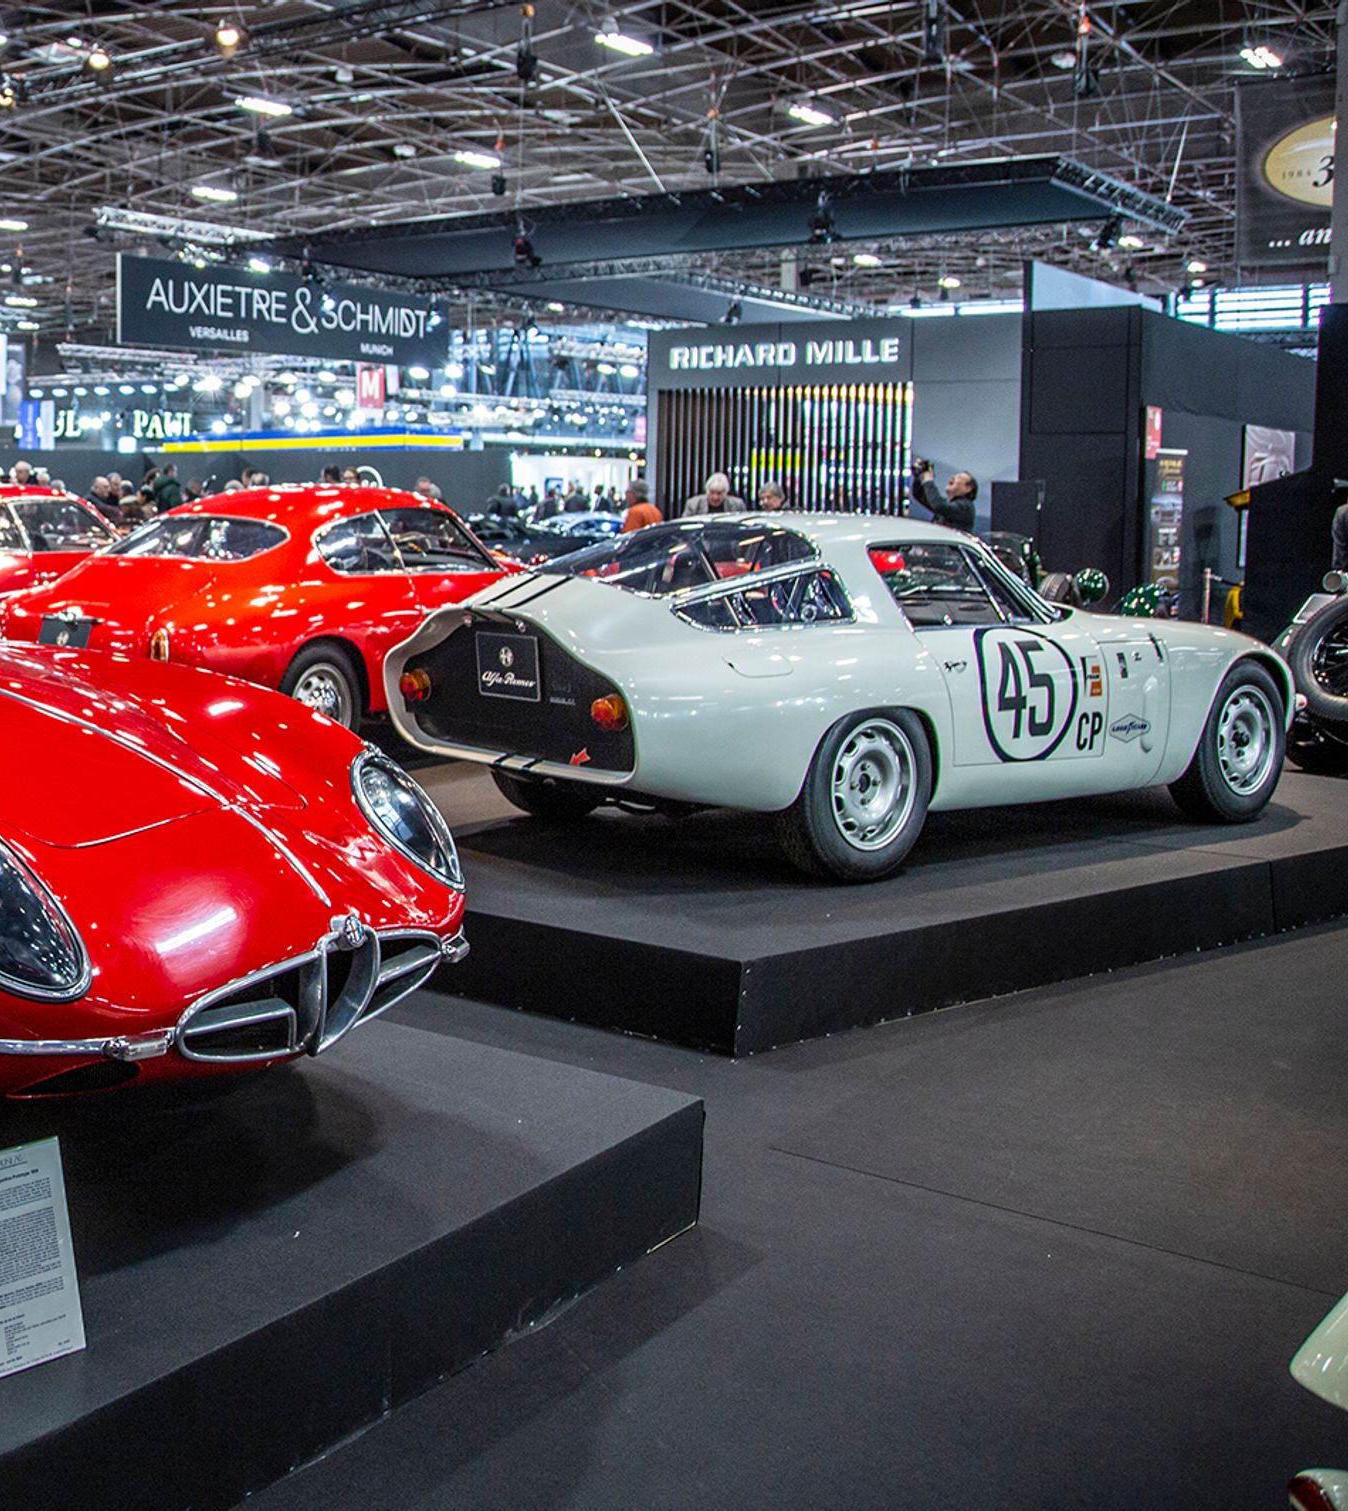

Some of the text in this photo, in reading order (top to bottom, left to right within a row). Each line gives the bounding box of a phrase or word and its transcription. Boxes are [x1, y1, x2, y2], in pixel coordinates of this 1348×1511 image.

[146, 278, 427, 339] AUXIETRE & SCHMIDT
[189, 325, 250, 343] VERSAILLES
[360, 342, 394, 356] MUNICH
[668, 338, 899, 370] RICHARD MILLE
[361, 370, 379, 400] M
[997, 640, 1055, 740] 45
[1075, 711, 1103, 751] CP
